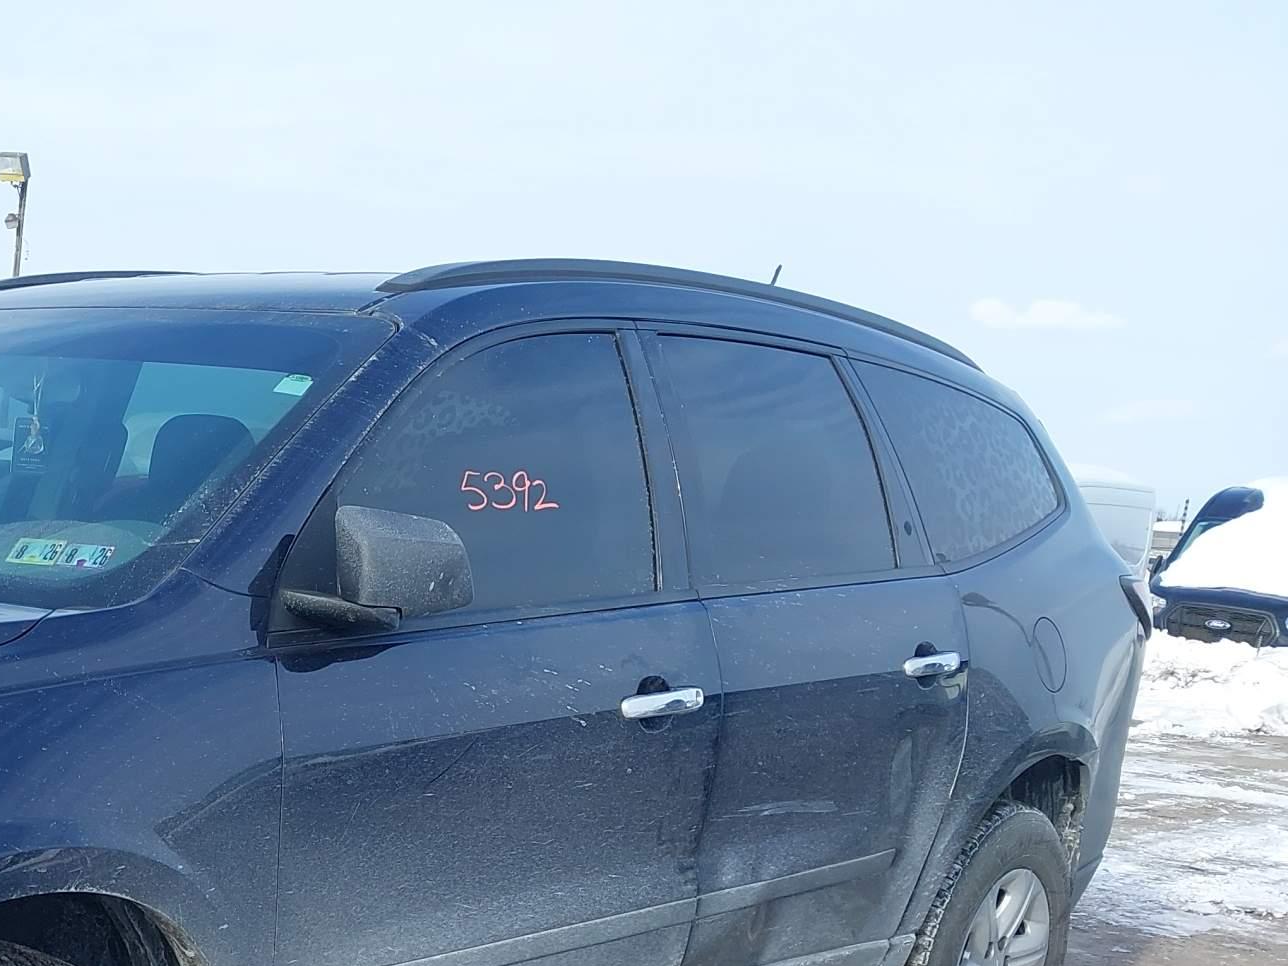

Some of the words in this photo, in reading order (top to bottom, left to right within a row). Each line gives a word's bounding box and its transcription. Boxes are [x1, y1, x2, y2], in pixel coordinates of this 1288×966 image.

[460, 470, 560, 513] 5392
[15, 544, 29, 560] 8
[65, 548, 79, 564] 8
